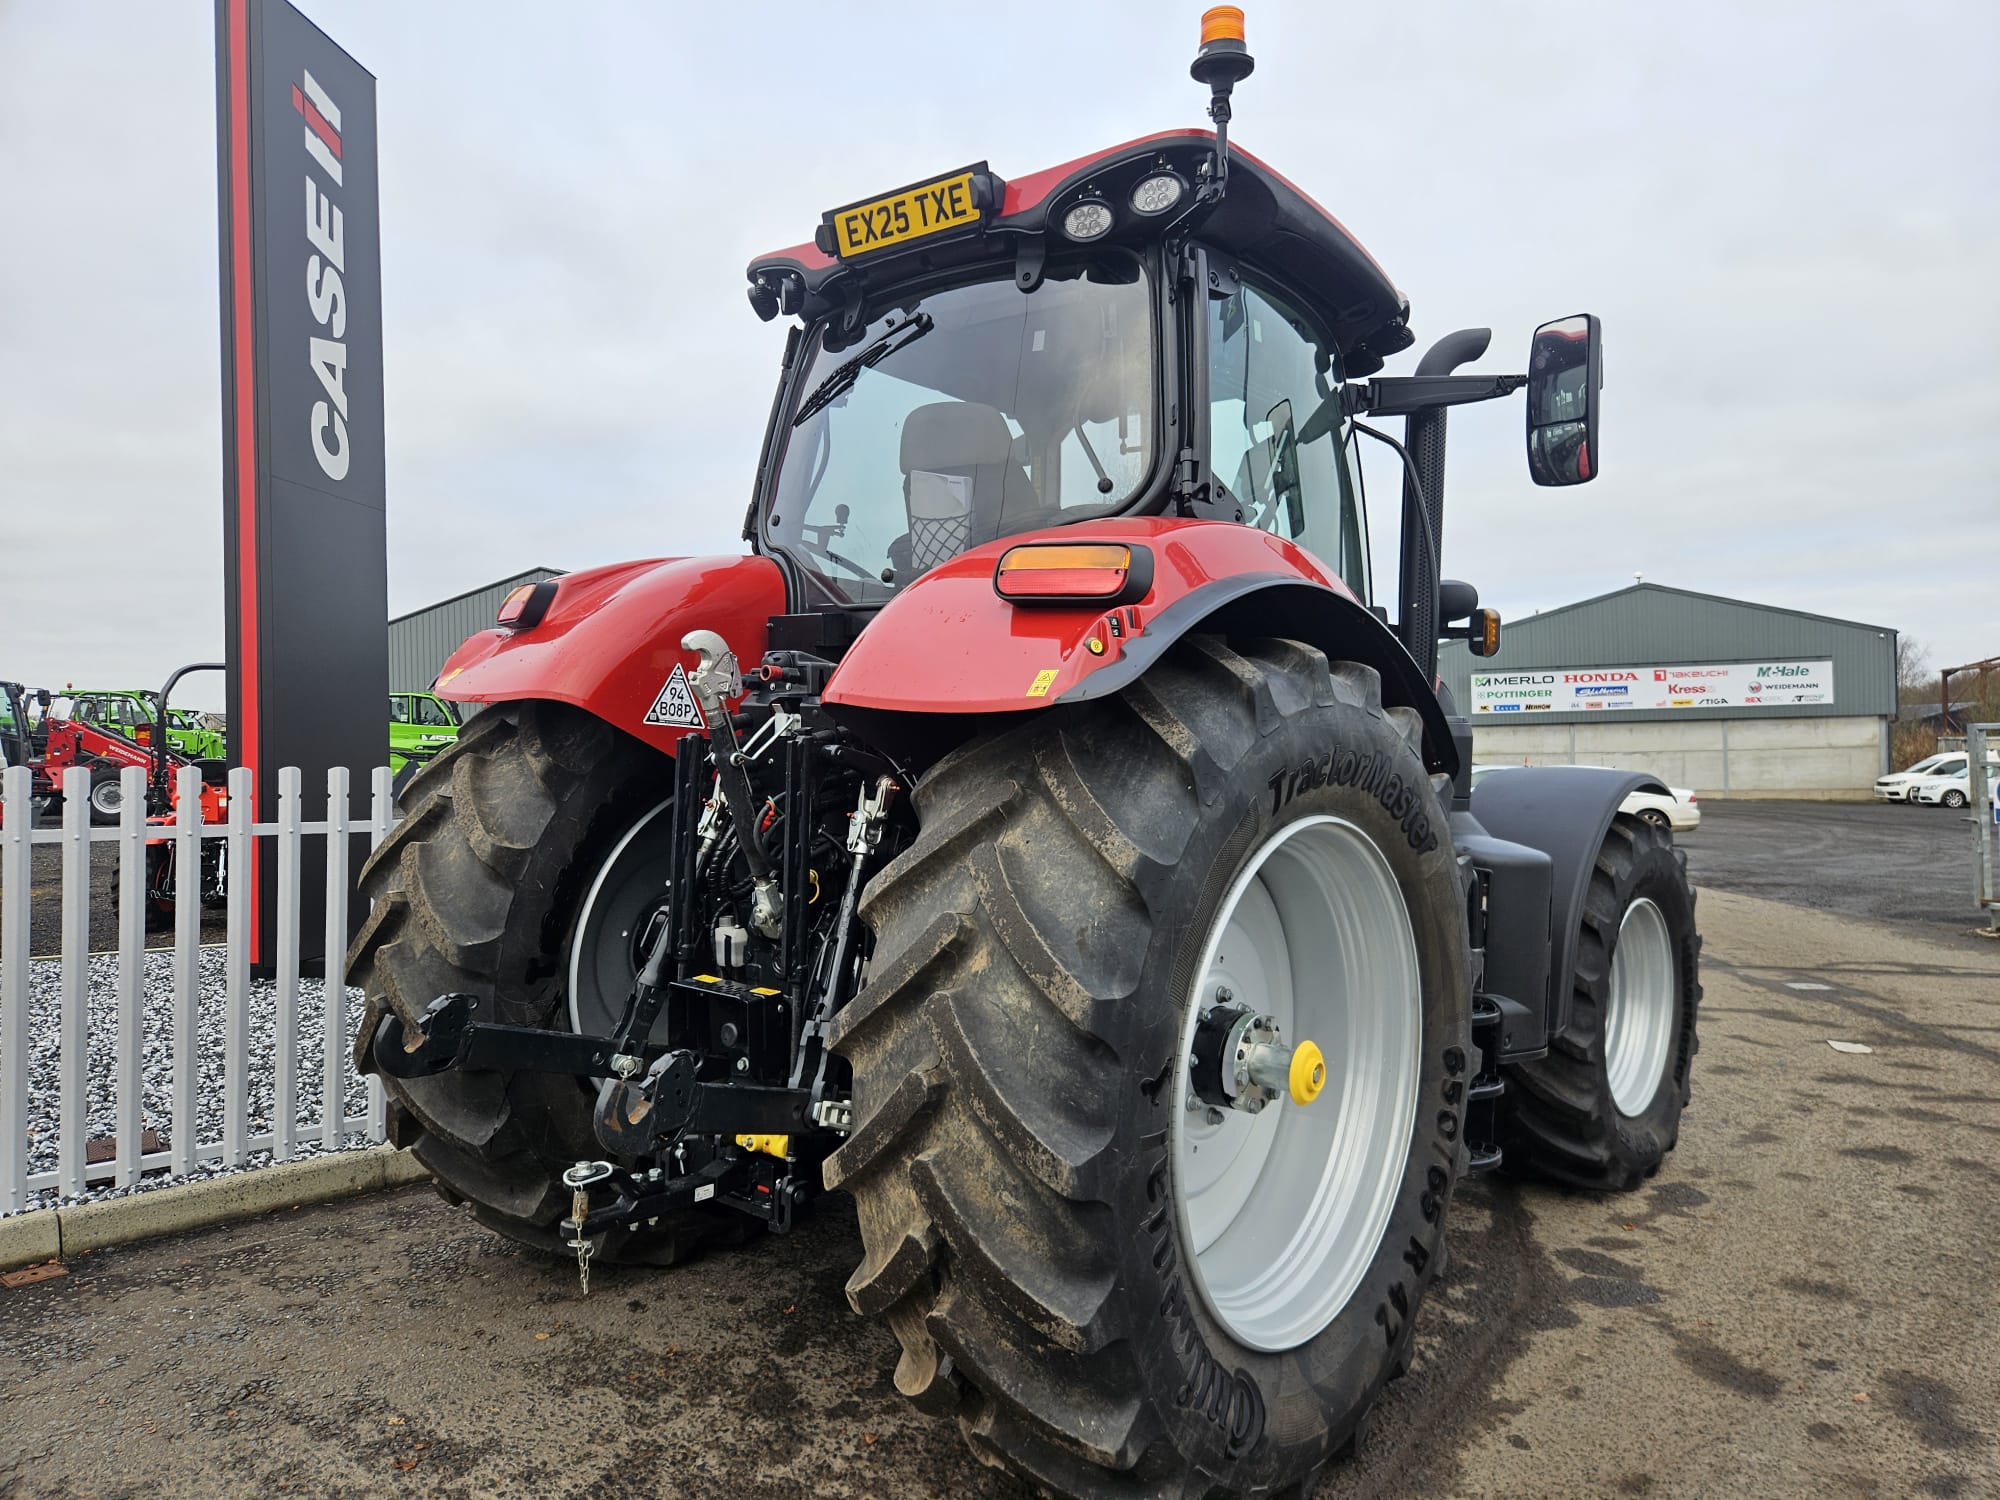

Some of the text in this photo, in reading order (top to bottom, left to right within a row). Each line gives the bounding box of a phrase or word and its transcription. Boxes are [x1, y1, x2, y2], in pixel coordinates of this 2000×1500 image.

[844, 183, 968, 248] EX25 TXE
[305, 176, 350, 481] CASE
[1494, 675, 1554, 686] MERLO
[1563, 672, 1639, 683] HONDA
[1668, 683, 1706, 694] Kress
[1765, 682, 1819, 690] WEIDEMANN
[669, 687, 684, 702] 94
[1267, 744, 1438, 855] TractorMaster
